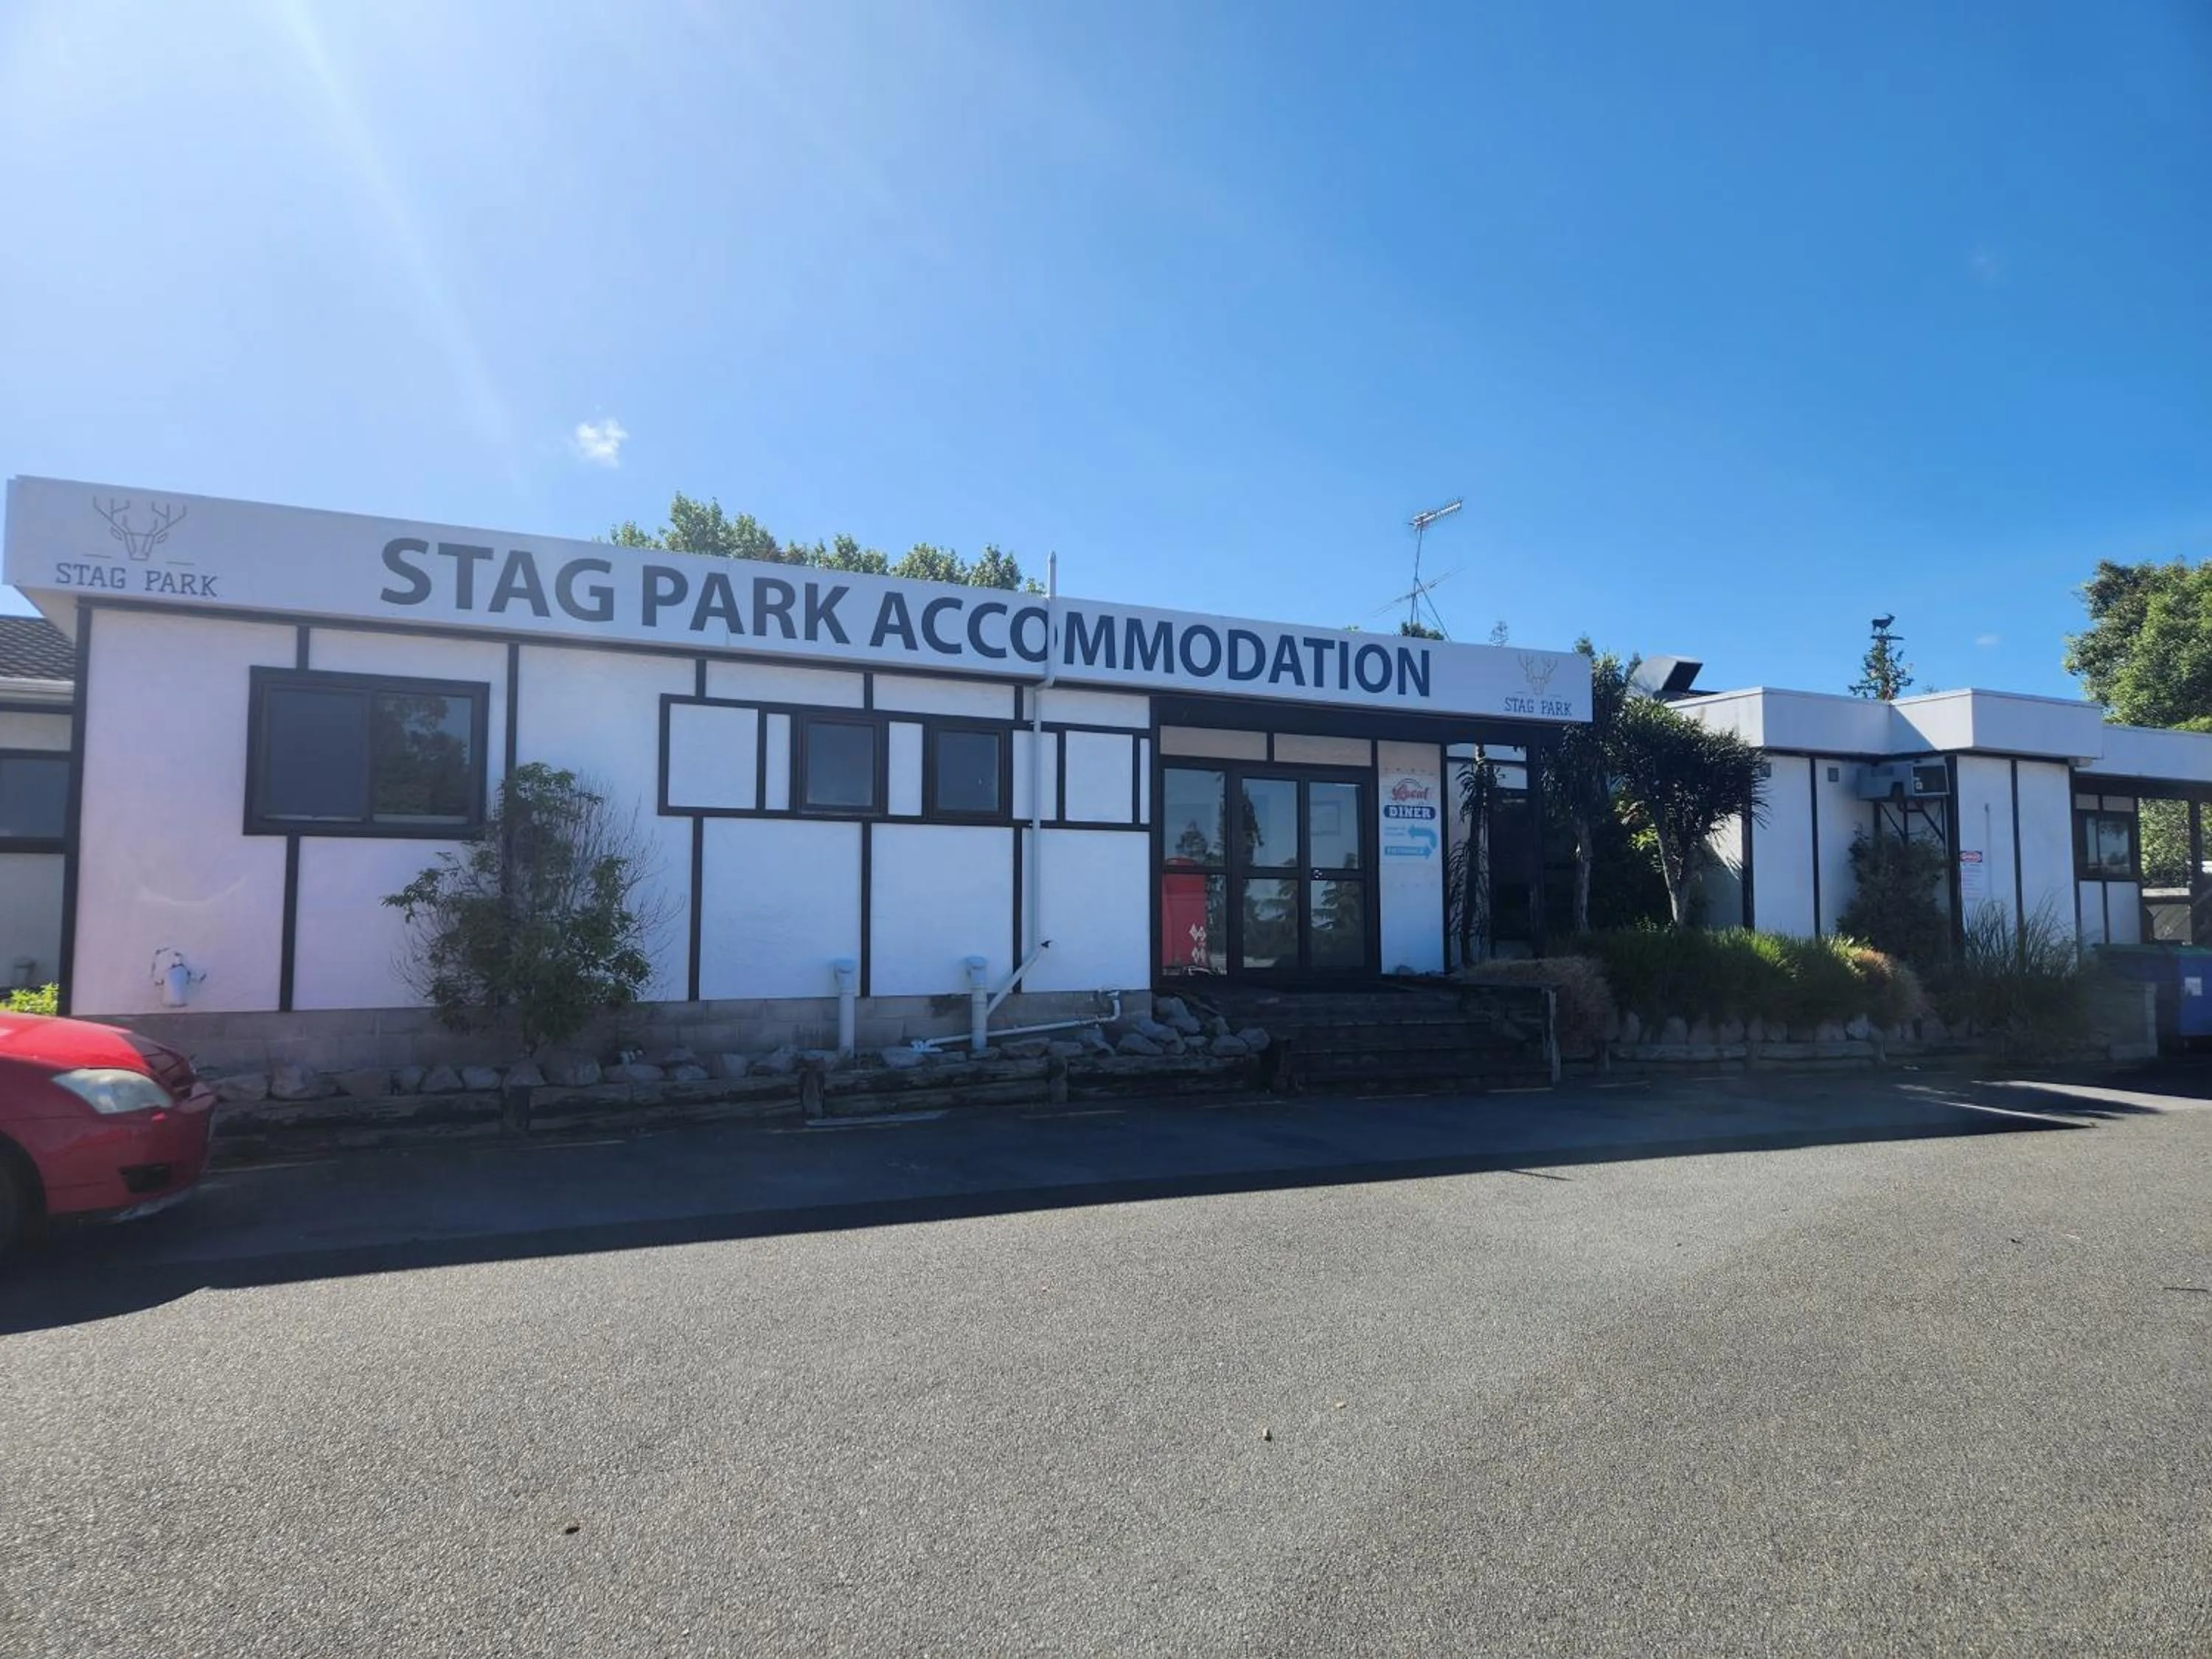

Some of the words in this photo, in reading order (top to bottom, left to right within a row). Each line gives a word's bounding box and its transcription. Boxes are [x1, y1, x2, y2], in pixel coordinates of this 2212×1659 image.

[56, 563, 127, 589] STAG
[145, 569, 218, 597] PARK
[380, 538, 614, 622] STAG
[641, 565, 849, 645] PARK
[869, 591, 1430, 698] ACCOMMODATION
[1505, 698, 1534, 714] STAG
[1541, 700, 1572, 717] PARK
[1389, 807, 1431, 818] DINER
